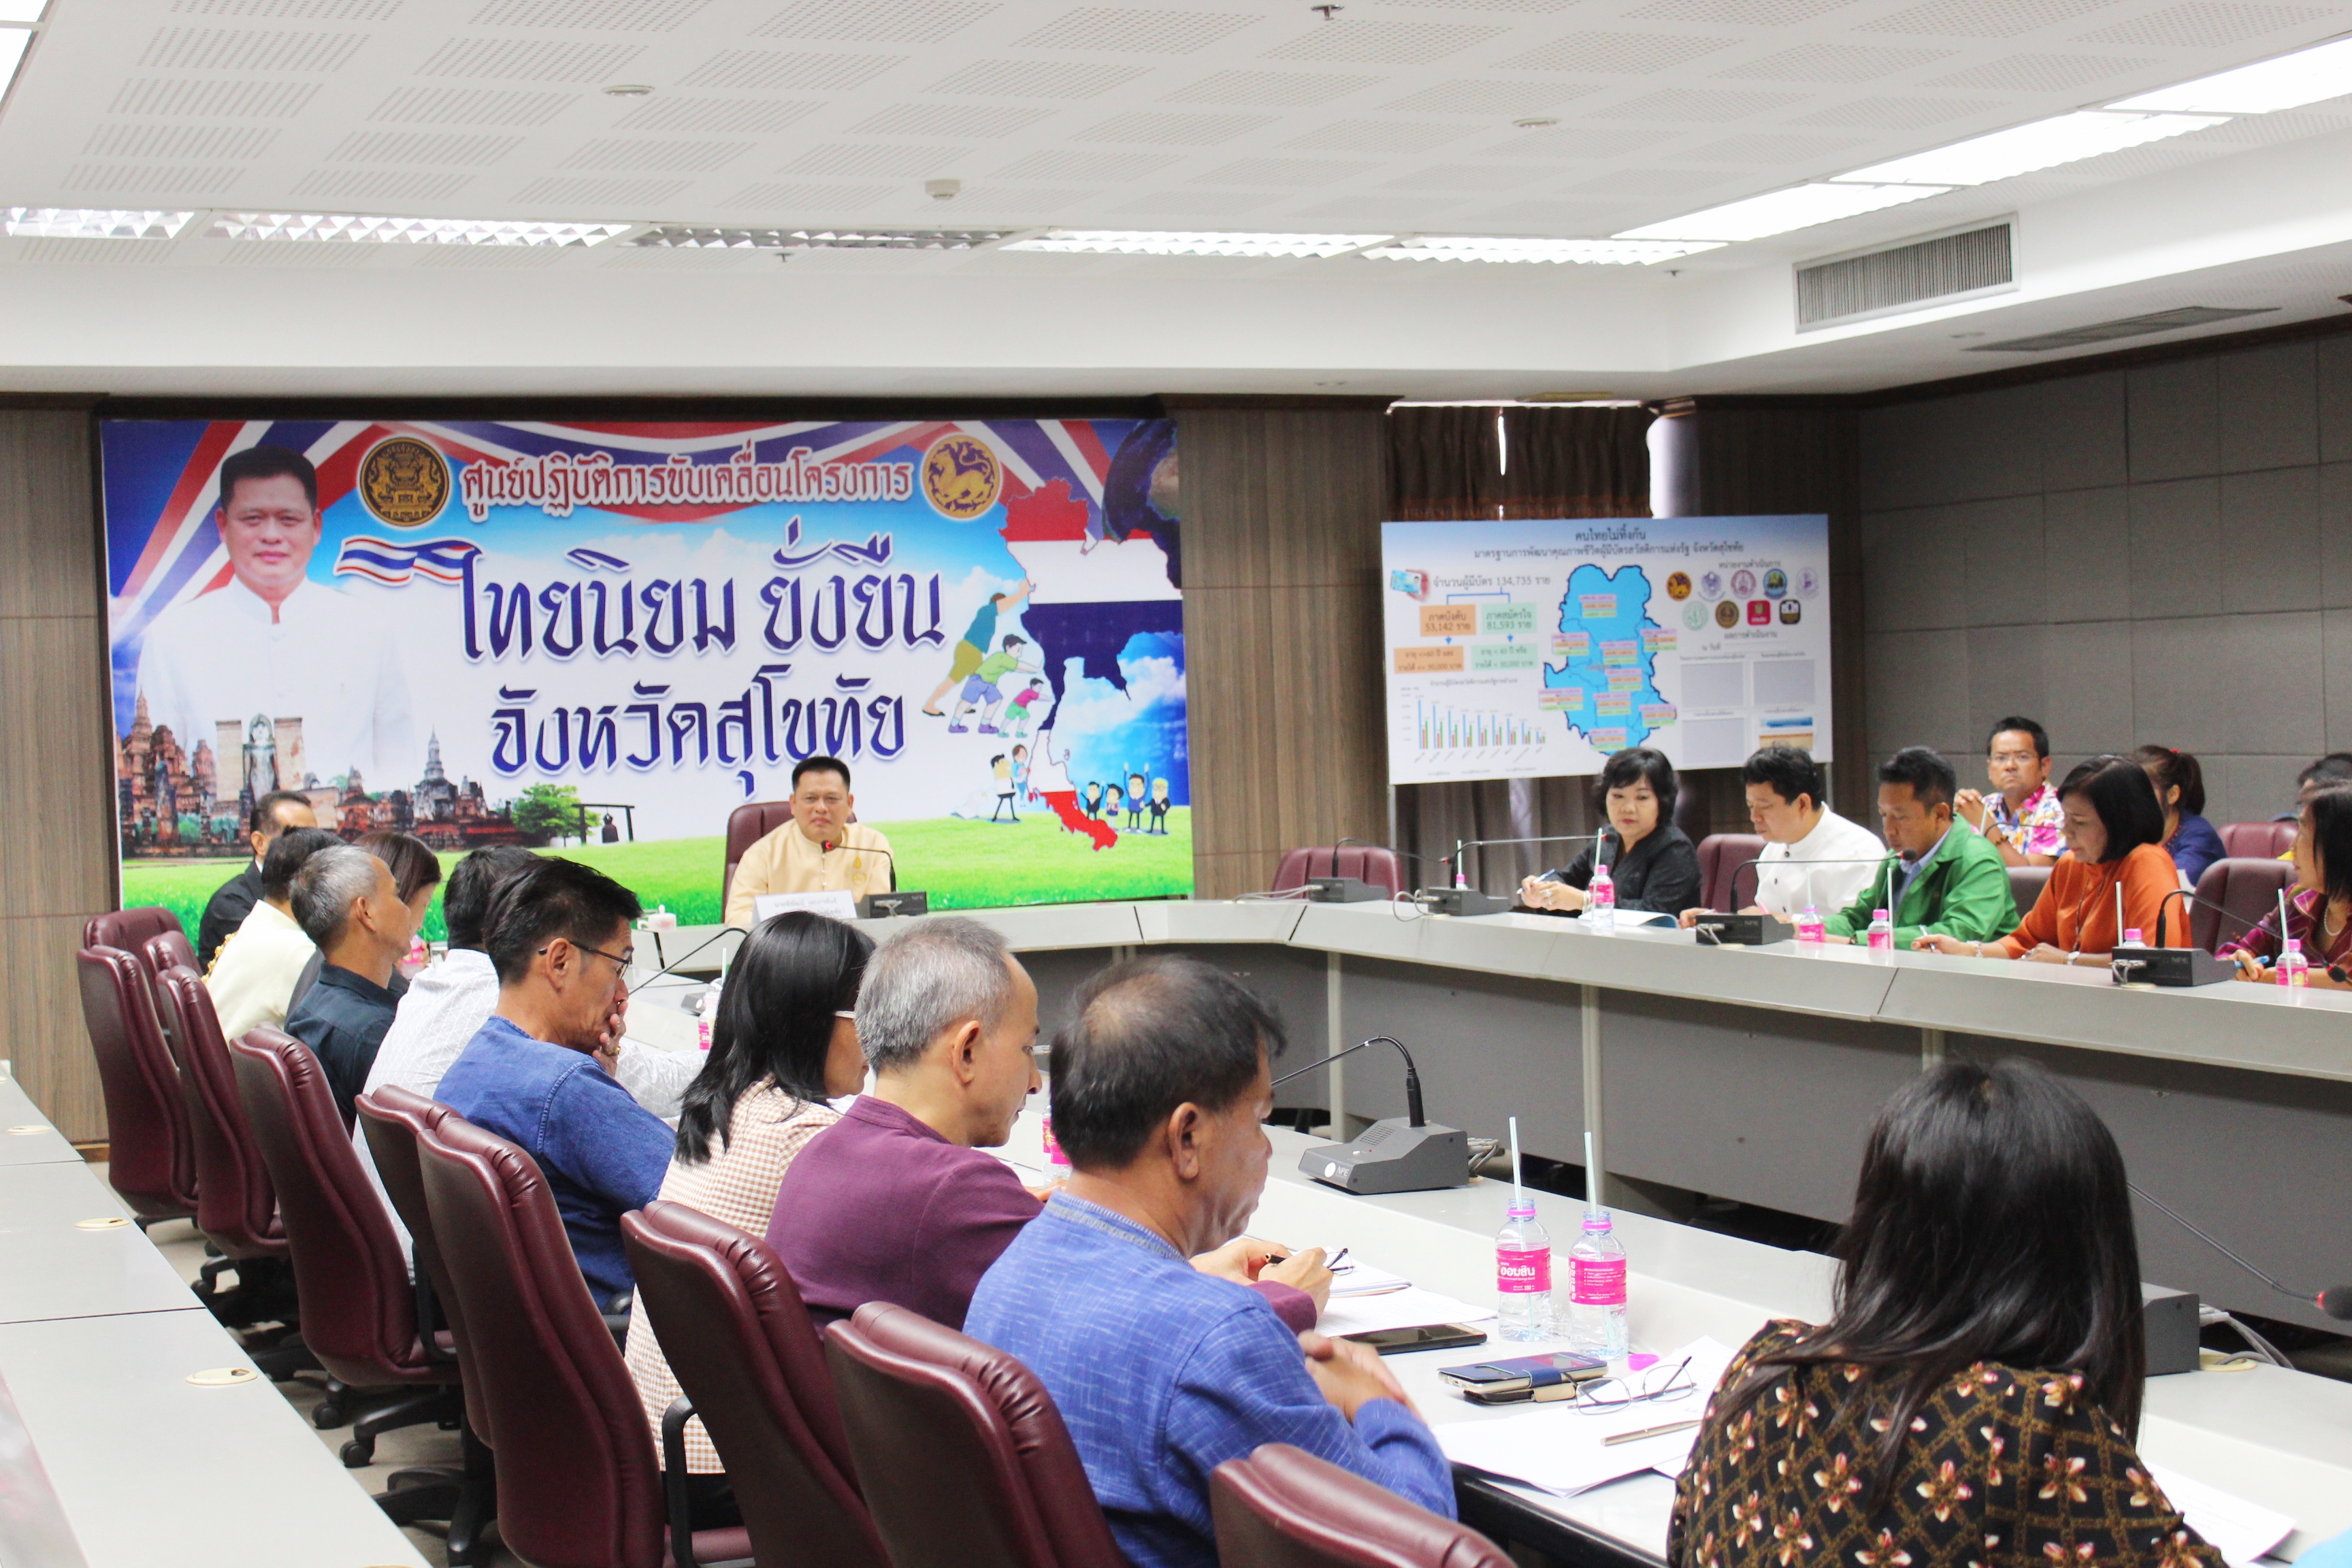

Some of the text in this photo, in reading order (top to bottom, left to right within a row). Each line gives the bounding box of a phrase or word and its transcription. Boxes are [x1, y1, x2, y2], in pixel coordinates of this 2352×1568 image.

[463, 439, 912, 520] ศูนย์ปฏิบัติการขับเคลื่อนโครงการ
[1575, 523, 1647, 542] คนไทยไม่ทิ้งกัน
[461, 517, 945, 659] ไทยนิยม ยั่งยืน
[1496, 576, 1533, 587] 134,735
[1535, 576, 1551, 585] ราย
[1424, 622, 1471, 632] 53,142 ราย
[1486, 621, 1532, 631] 81,593 ราย
[491, 665, 906, 798] จังหวัดสุโขทัย
[1336, 1166, 1350, 1177] NPE
[1500, 1264, 1535, 1277] ออมสิน
